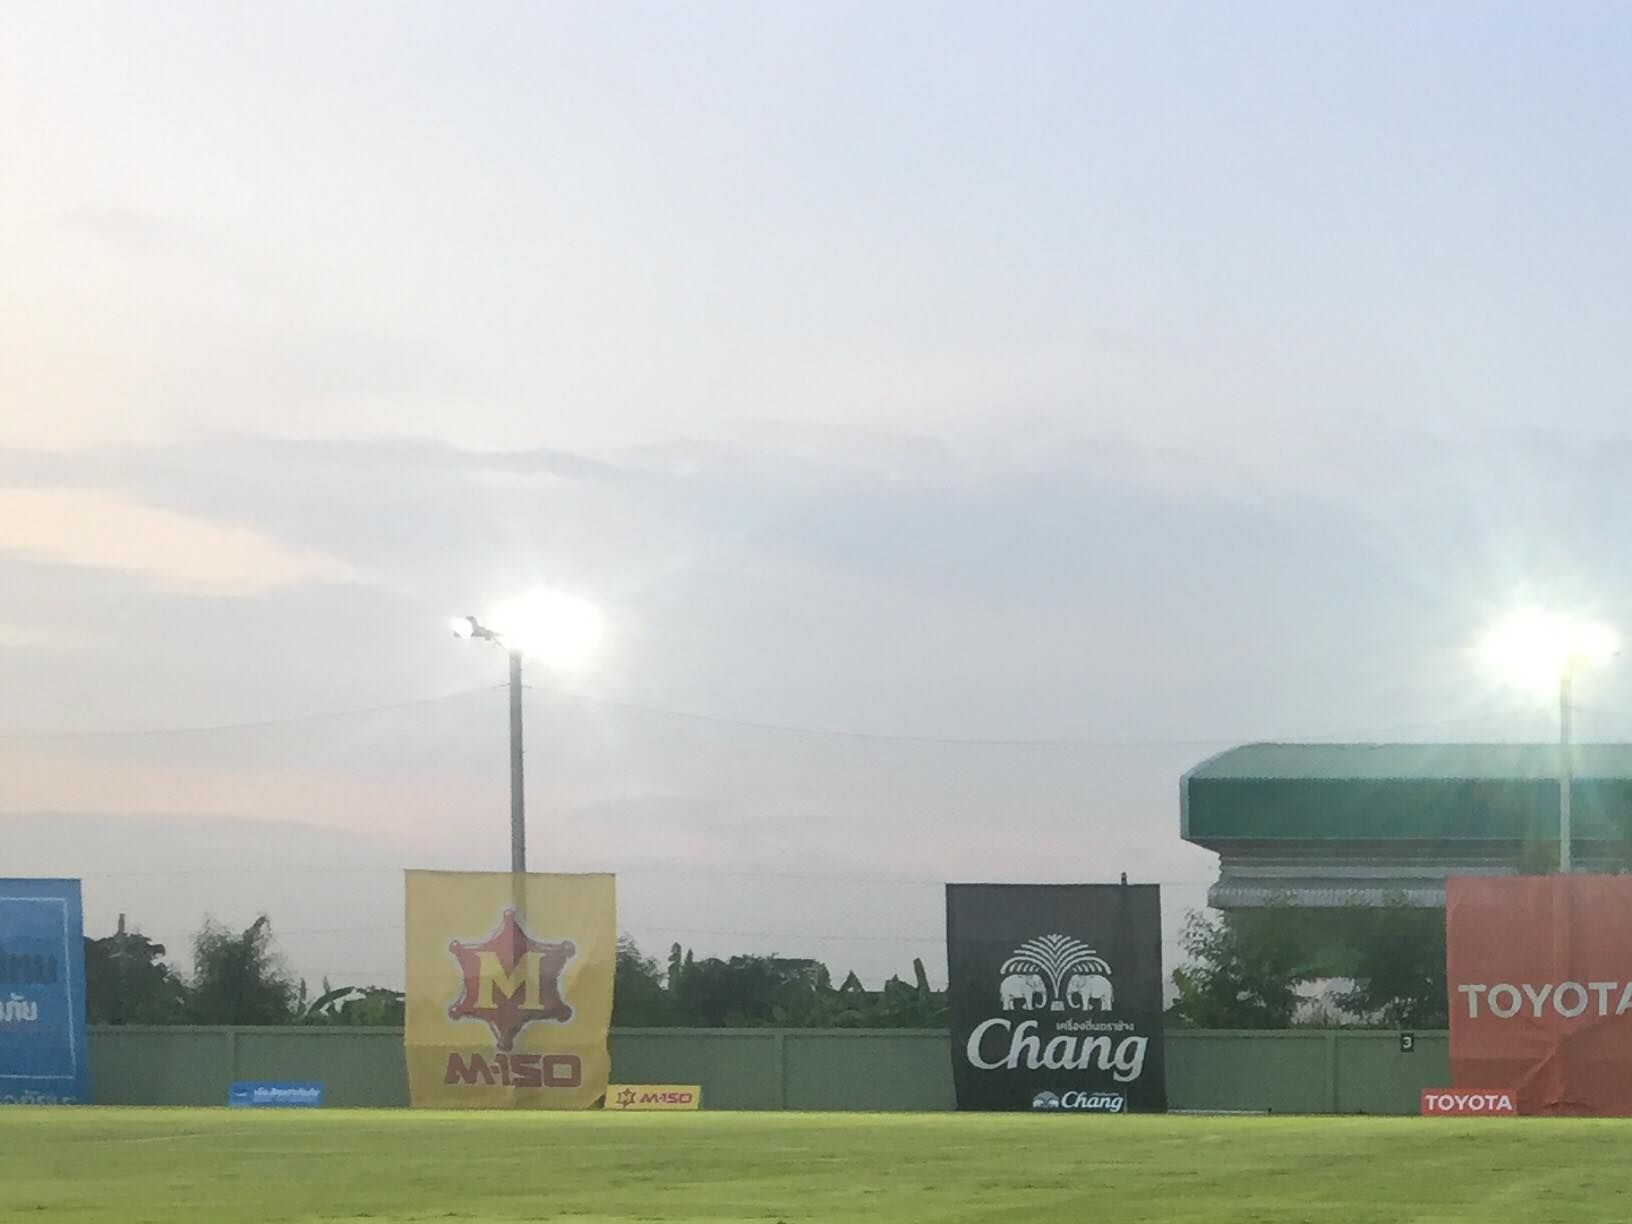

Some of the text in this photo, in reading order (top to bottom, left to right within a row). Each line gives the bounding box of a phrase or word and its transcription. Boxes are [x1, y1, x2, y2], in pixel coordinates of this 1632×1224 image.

[966, 1018, 1149, 1082] Chang
[1402, 1036, 1412, 1049] 3
[446, 1053, 582, 1088] M-150
[1061, 1091, 1124, 1112] Chang
[1425, 1094, 1513, 1111] TOYOTA
